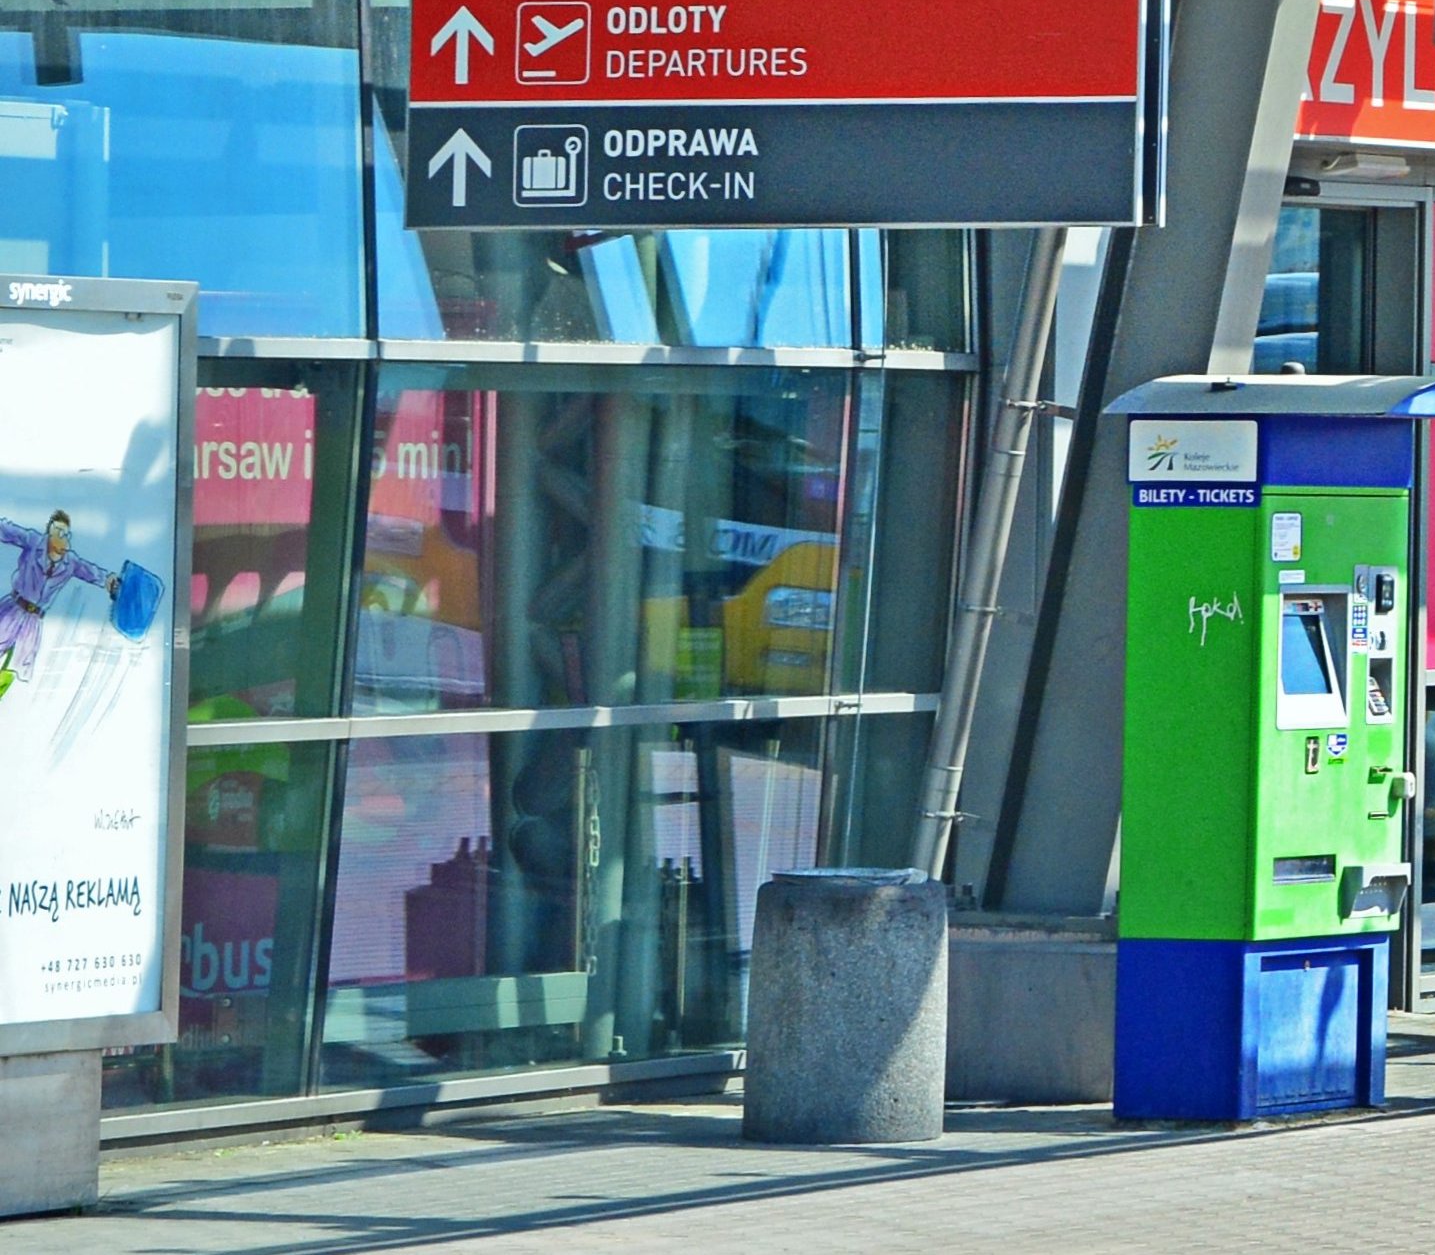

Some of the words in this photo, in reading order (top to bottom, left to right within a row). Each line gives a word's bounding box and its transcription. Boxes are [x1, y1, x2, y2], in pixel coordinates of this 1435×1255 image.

[606, 5, 725, 33] ODLOTY
[604, 47, 806, 77] DEPARTURES
[603, 128, 757, 156] ODPRAWA
[602, 171, 754, 199] CHECK-IN
[9, 278, 71, 305] synergic
[1139, 489, 1185, 502] BILETY
[1197, 489, 1254, 502] TICKETS
[8, 880, 58, 921] NASZĄ
[64, 875, 140, 915] REKLAMĄ
[41, 960, 60, 972] +48
[67, 958, 87, 970] 727
[94, 956, 114, 968] 630
[121, 953, 141, 966] 630
